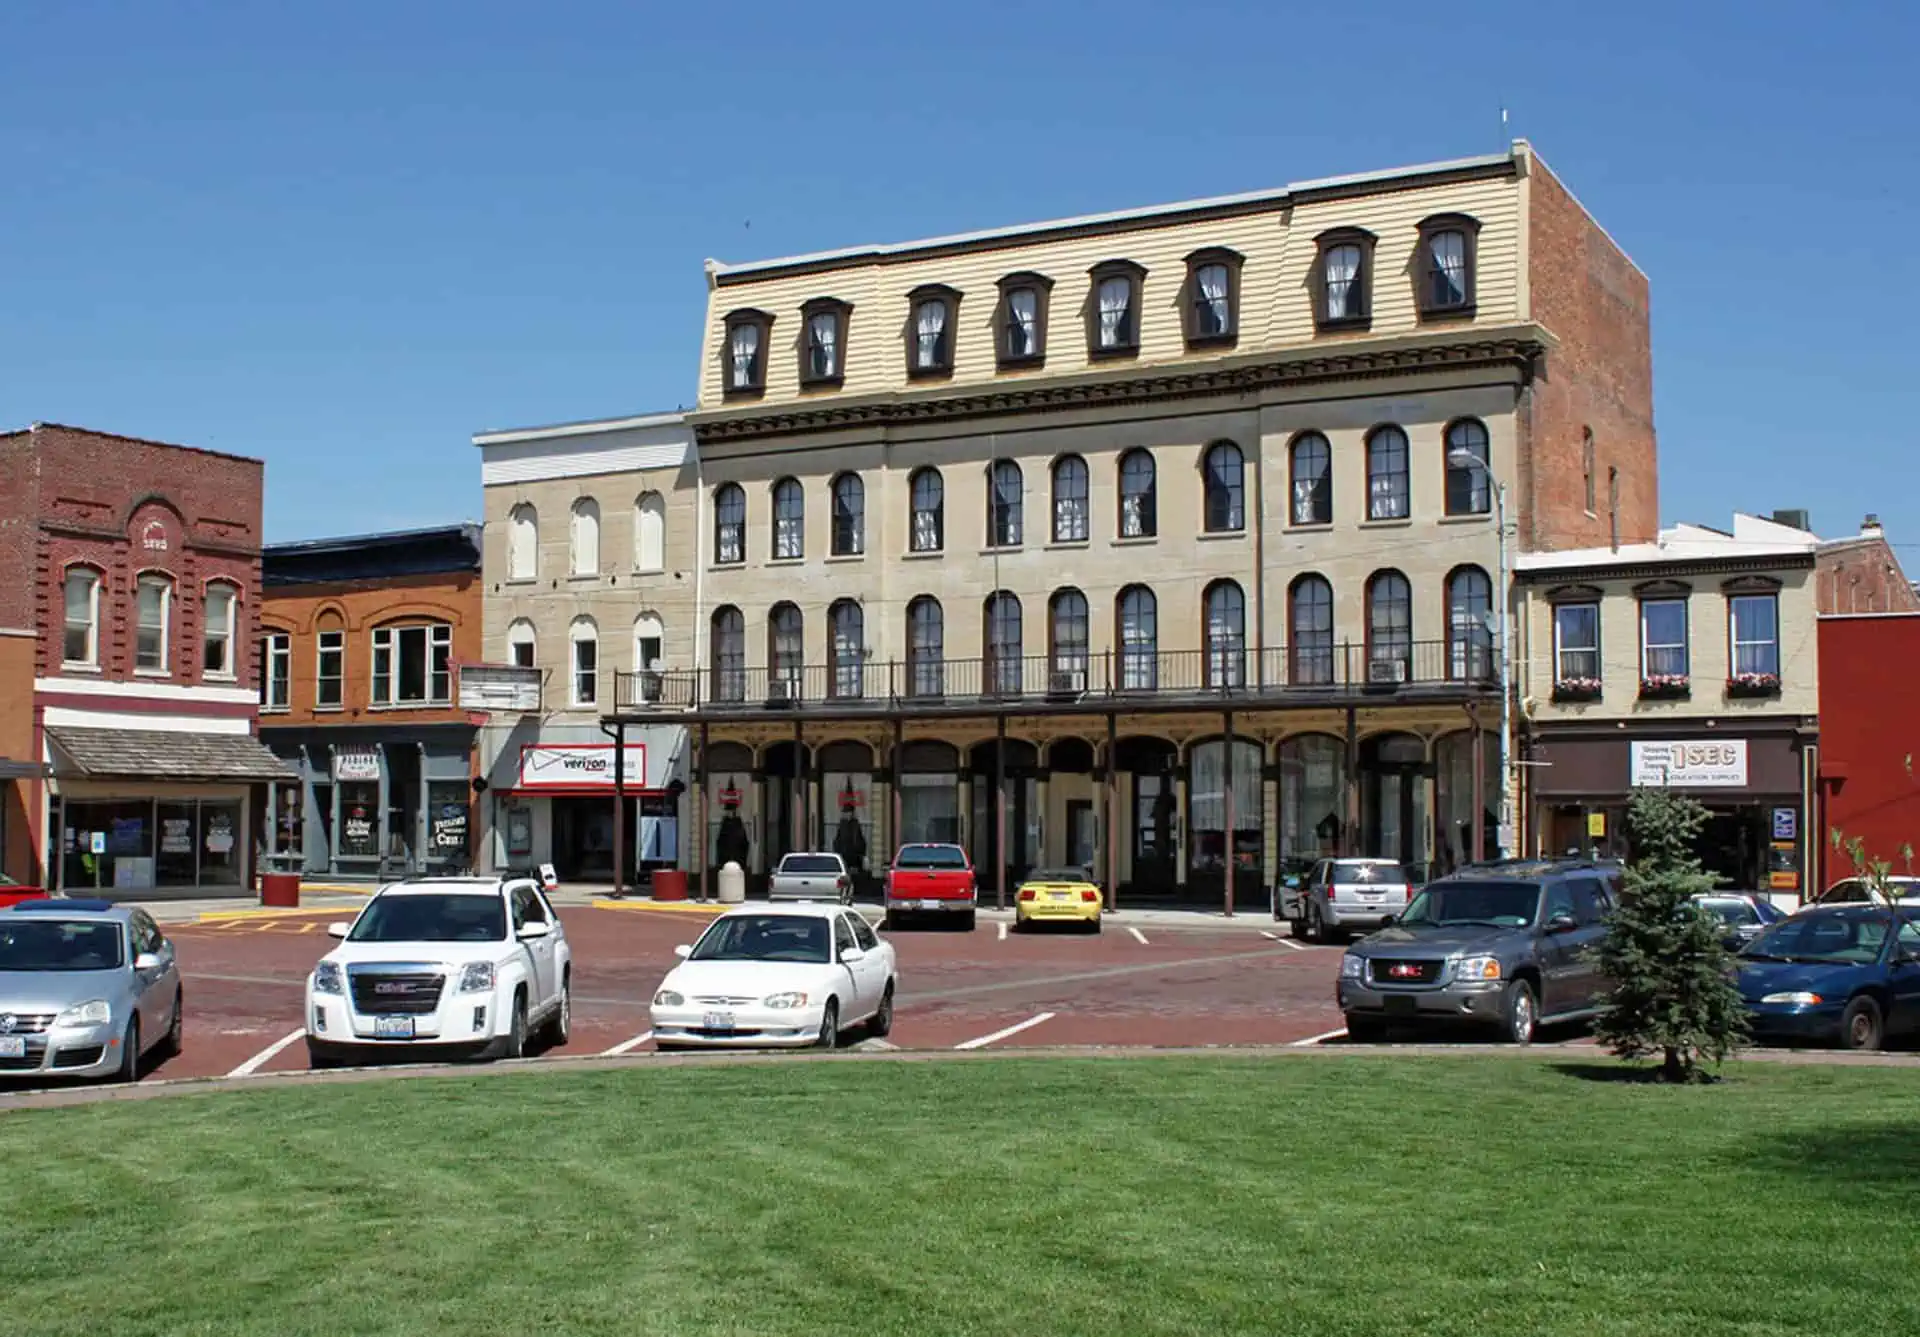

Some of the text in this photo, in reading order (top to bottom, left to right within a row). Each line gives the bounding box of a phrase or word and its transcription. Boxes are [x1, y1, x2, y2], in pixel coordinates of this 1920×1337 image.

[563, 756, 607, 771] verizon
[1388, 964, 1423, 977] GMC
[375, 983, 417, 993] GMC
